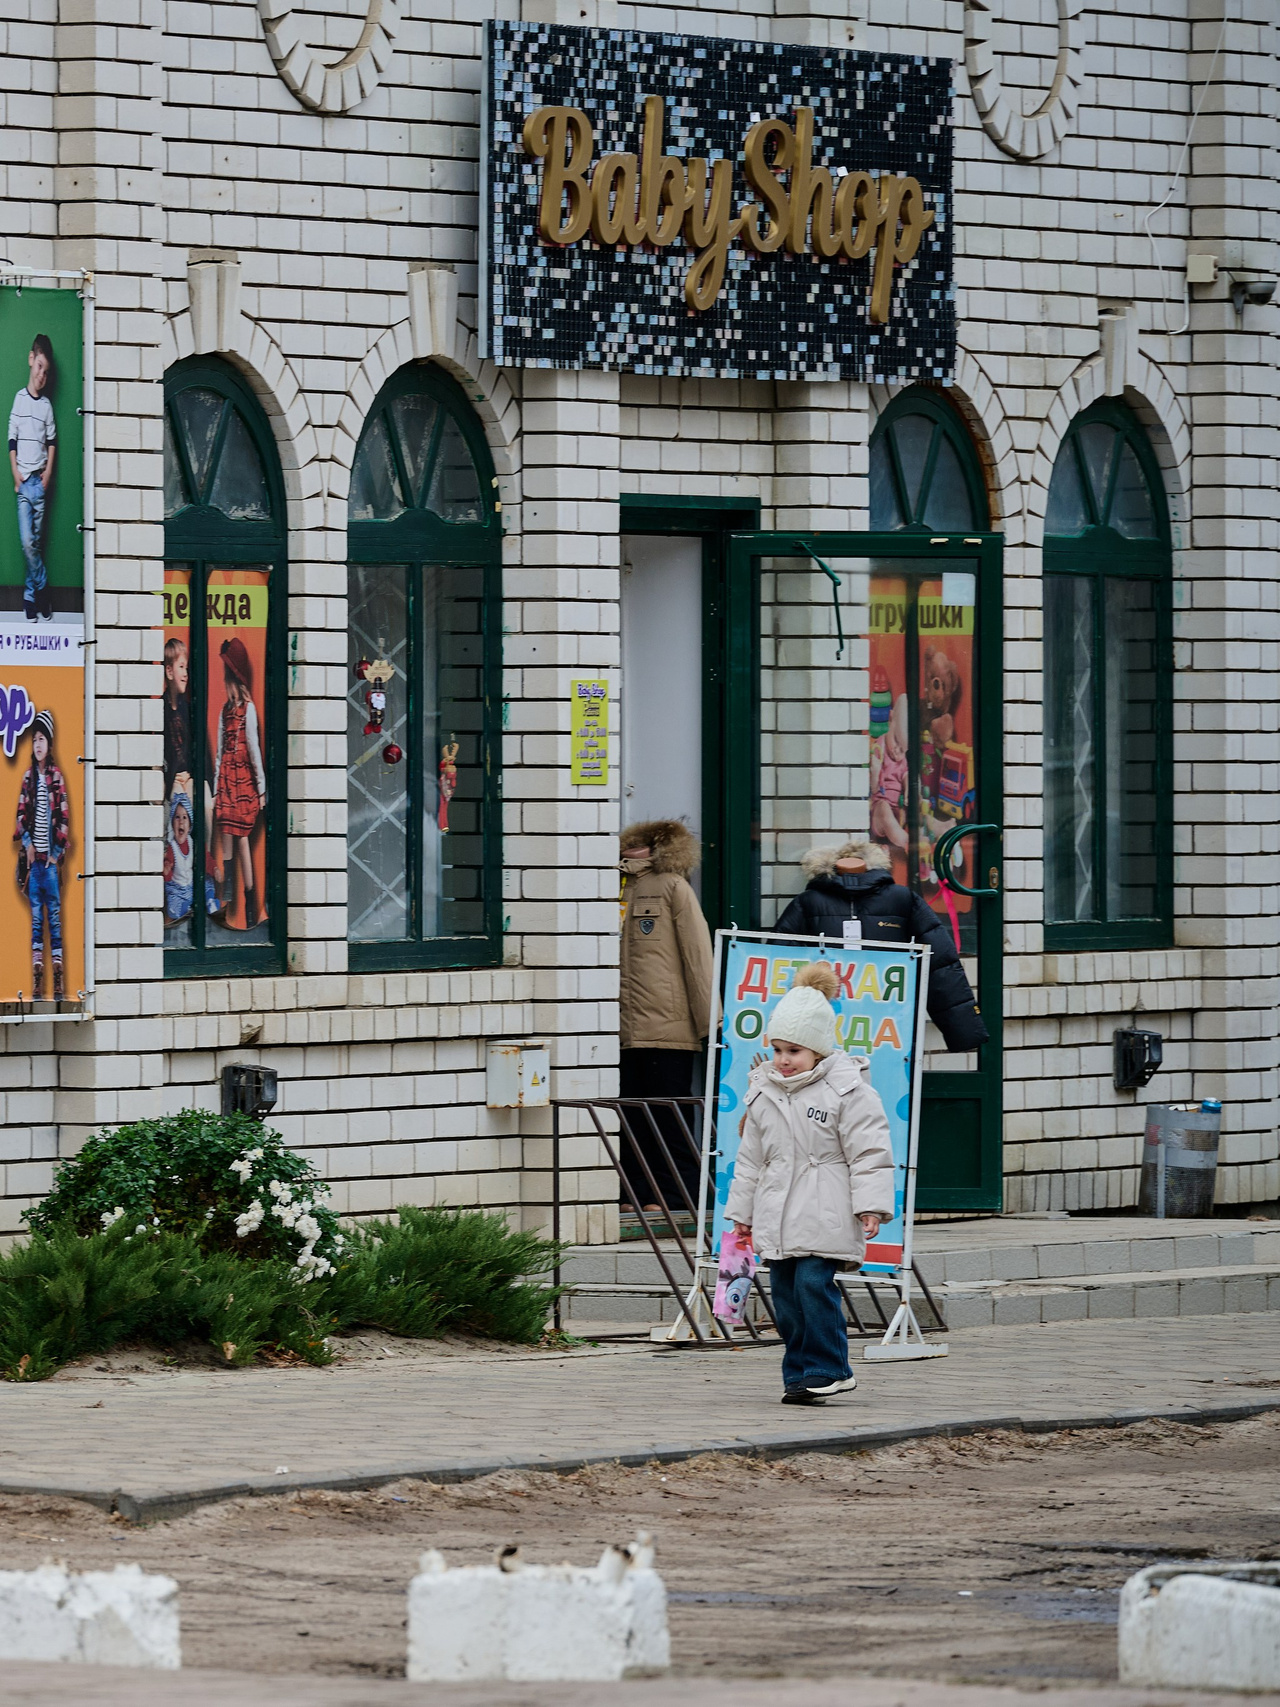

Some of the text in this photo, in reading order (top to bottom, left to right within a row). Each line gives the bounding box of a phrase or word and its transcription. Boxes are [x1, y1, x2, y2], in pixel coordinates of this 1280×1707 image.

[523, 96, 934, 324] Baby Shop
[15, 635, 61, 650] РУБАШКИ
[807, 1107, 828, 1123] OCU
